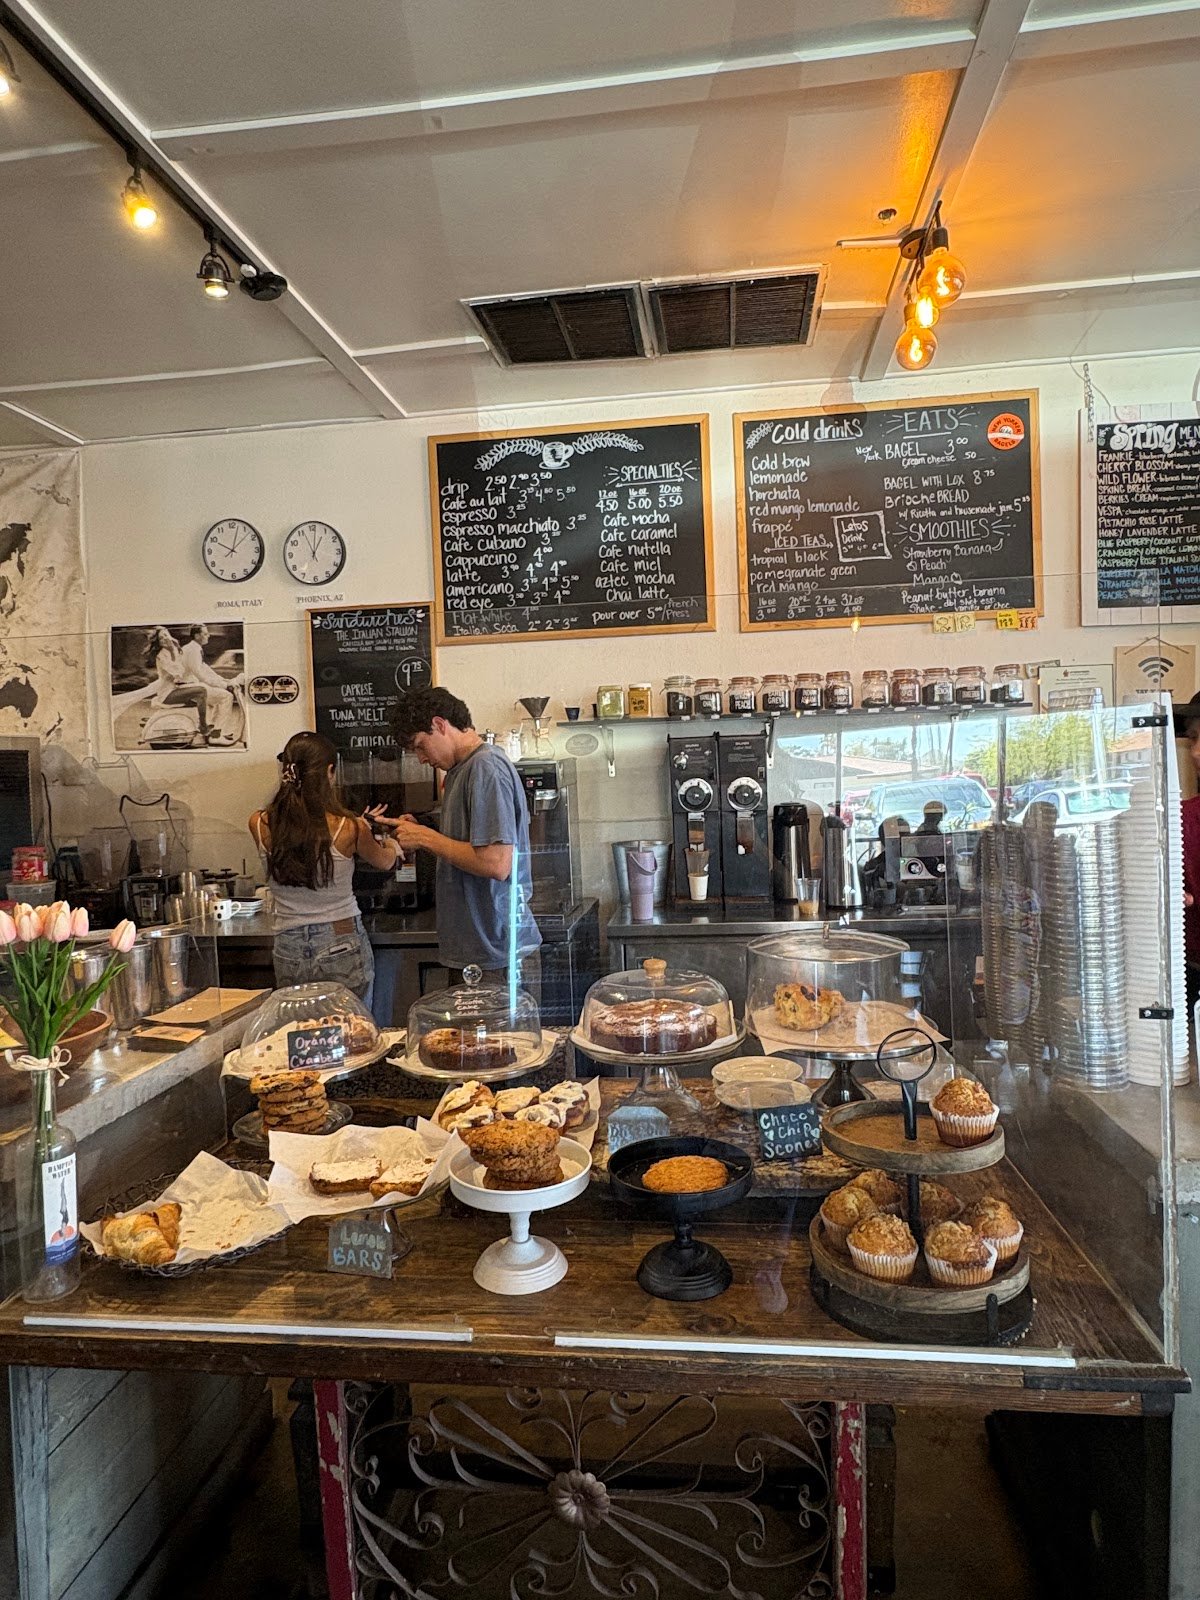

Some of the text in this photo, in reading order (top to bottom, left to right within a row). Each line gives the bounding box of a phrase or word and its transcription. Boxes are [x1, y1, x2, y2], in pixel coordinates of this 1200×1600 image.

[904, 408, 959, 433] EATS
[772, 420, 809, 444] Cold
[1109, 422, 1179, 454] Spring
[855, 444, 883, 464] New York
[885, 441, 927, 460] BAGEL
[1098, 449, 1135, 462] FRANKIE
[751, 452, 810, 471] Cold brew
[902, 456, 926, 468] cream
[926, 453, 956, 465] cheese
[1097, 461, 1132, 473] CHERRY
[1134, 460, 1174, 472] BLOSSOM
[620, 462, 683, 482] SPECIALTIES
[749, 469, 808, 486] lemonade
[1096, 473, 1120, 485] WILD
[1122, 472, 1158, 484] FLOWER
[441, 477, 469, 500] drip
[884, 476, 918, 491] BAGEL
[921, 474, 943, 487] WITH
[946, 473, 966, 487] LOX
[1098, 485, 1125, 495] SPRING
[1127, 483, 1153, 493] BREAK
[470, 498, 485, 508] au
[488, 486, 507, 506] lait
[748, 485, 801, 502] horchata
[884, 488, 970, 510] Brioche BREAD
[1098, 494, 1129, 505] BERRIES
[595, 499, 619, 513] 4.50
[627, 497, 652, 510] 5.00
[658, 495, 683, 509] 5.50
[442, 507, 497, 526] espresso
[749, 499, 860, 522] red mango lemonade
[910, 507, 937, 520] Ricotta
[940, 507, 953, 517] and
[1097, 505, 1123, 517] VESPA
[443, 515, 560, 541] espresso macchiato
[752, 518, 794, 538] frappé
[1098, 514, 1184, 528] PISTACHIO ROSE LATTE
[251, 534, 257, 542] 2
[908, 517, 991, 543] SMOOTHIES
[1098, 524, 1198, 539] HONEY LAVENDER LATTE
[773, 533, 827, 550] ICED TEAS
[841, 532, 866, 545] Drink
[207, 548, 213, 556] 9
[627, 541, 672, 557] nutella
[903, 543, 992, 563] Strawberry Banana
[210, 560, 216, 568] 8
[634, 556, 661, 573] miel
[750, 550, 829, 569] tropical black
[920, 558, 947, 571] Peach
[1159, 555, 1189, 566] ITALIAN
[219, 569, 225, 577] 7
[231, 572, 237, 580] 6
[243, 568, 249, 576] 5
[446, 568, 482, 583] latte
[749, 563, 857, 585] pomegranate green
[595, 573, 677, 589] aztec mocha
[756, 580, 776, 594] red
[333, 593, 344, 602] AZ
[446, 582, 515, 598] americano
[638, 585, 670, 599] latte
[902, 587, 934, 604] Peanut
[972, 584, 1006, 597] banana
[241, 599, 263, 608] ITALY
[447, 596, 495, 615] red eye
[322, 608, 417, 630] Sandwiches
[592, 610, 642, 626] pour over
[333, 624, 418, 641] THE ITALIAN STALLION
[453, 624, 489, 638] Italian
[341, 682, 375, 698] CAPRESE
[735, 700, 751, 710] PEACH
[329, 707, 386, 721] TUNA MELT
[295, 1034, 340, 1050] Orange
[333, 1246, 384, 1271] BARS
